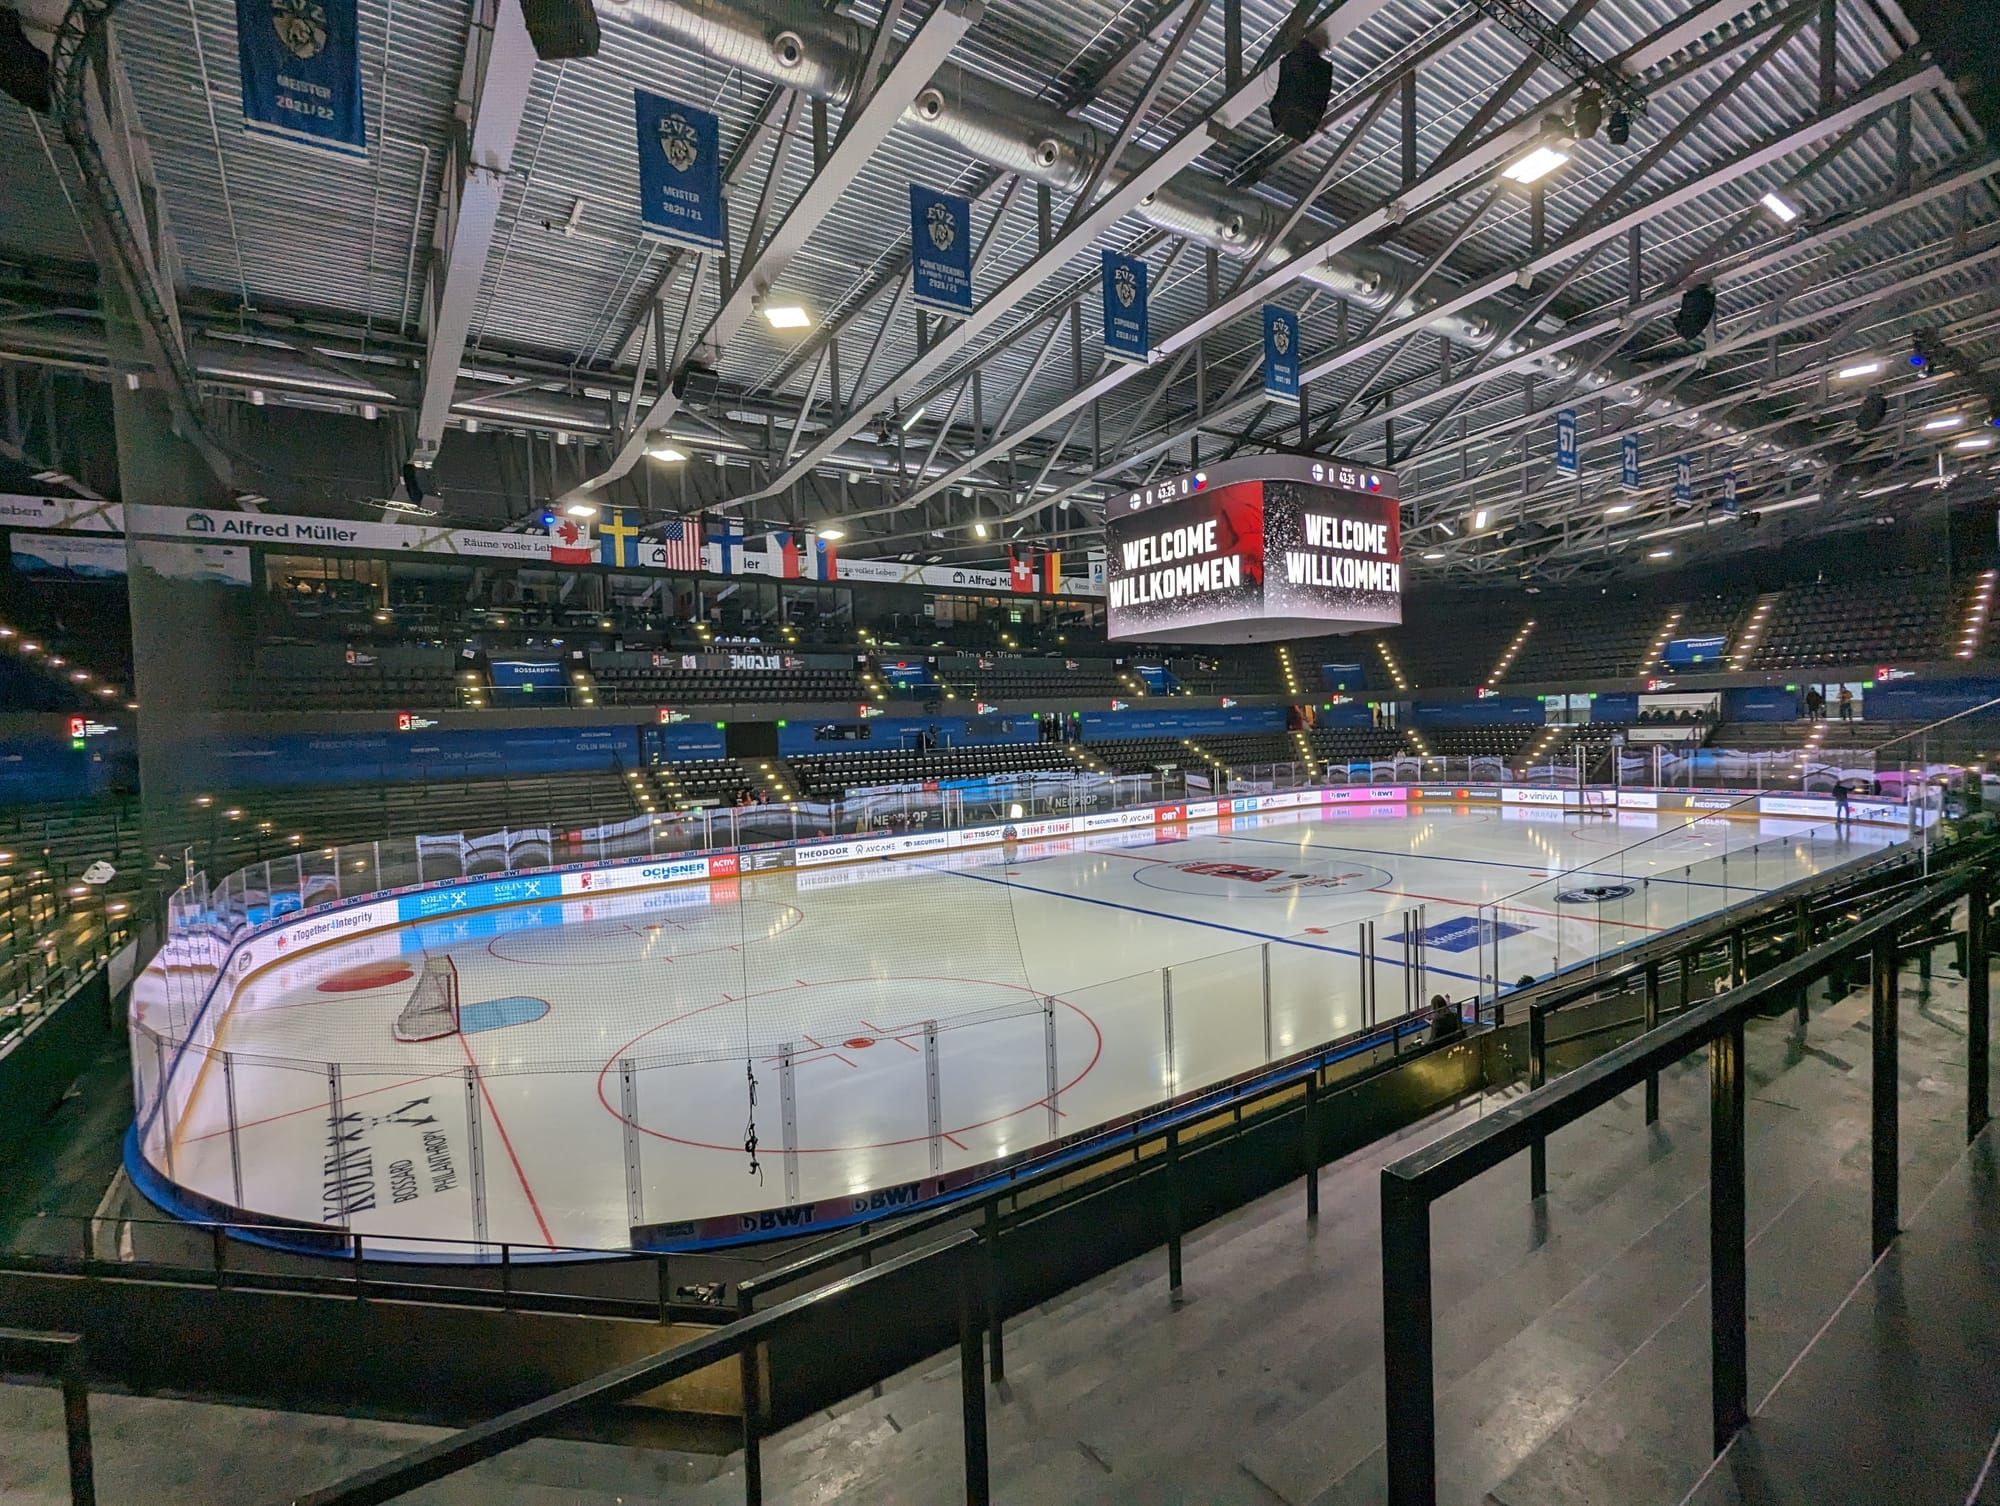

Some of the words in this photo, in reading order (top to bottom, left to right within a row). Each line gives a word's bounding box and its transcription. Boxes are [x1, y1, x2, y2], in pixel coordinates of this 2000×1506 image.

[276, 74, 331, 98] MEISTER
[275, 95, 334, 120] 2021/22
[659, 118, 697, 141] EVZ
[662, 185, 699, 203] MEISTER
[927, 207, 955, 226] EVZ
[1114, 269, 1136, 284] EVZ
[1273, 321, 1290, 335] EVZ
[1328, 468, 1334, 482] 0
[1360, 474, 1365, 489] 0
[1146, 490, 1152, 505] 0
[1182, 479, 1188, 494] 0
[223, 519, 289, 537] Alfred
[296, 524, 358, 542] Müller
[1305, 513, 1387, 555] WELCOME
[463, 537, 498, 549] Räume
[502, 541, 531, 551] voller
[1123, 520, 1217, 571] WELCOME
[854, 568, 873, 576] voller
[875, 568, 896, 577] Leben
[968, 575, 997, 587] Alfred
[1109, 555, 1240, 609] WILLKOMMEN
[1286, 551, 1400, 593] WILLKOMMEN
[1055, 795, 1098, 809] NEOPROP
[913, 838, 945, 847] SECURITAS
[974, 830, 1000, 838] TISSOT
[713, 859, 735, 867] ACTIV
[798, 847, 849, 859] THEODOOR
[642, 863, 705, 878] OCHSNER
[494, 882, 523, 893] KOLIN
[420, 892, 448, 905] KOLIN
[293, 912, 373, 942] #Together4Integrity
[422, 1129, 459, 1193] PHILANTHROPY
[323, 1146, 376, 1222] KOLIN
[389, 1159, 418, 1204] BOSSARD
[870, 1184, 919, 1210] BWT
[760, 1205, 816, 1232] BWT
